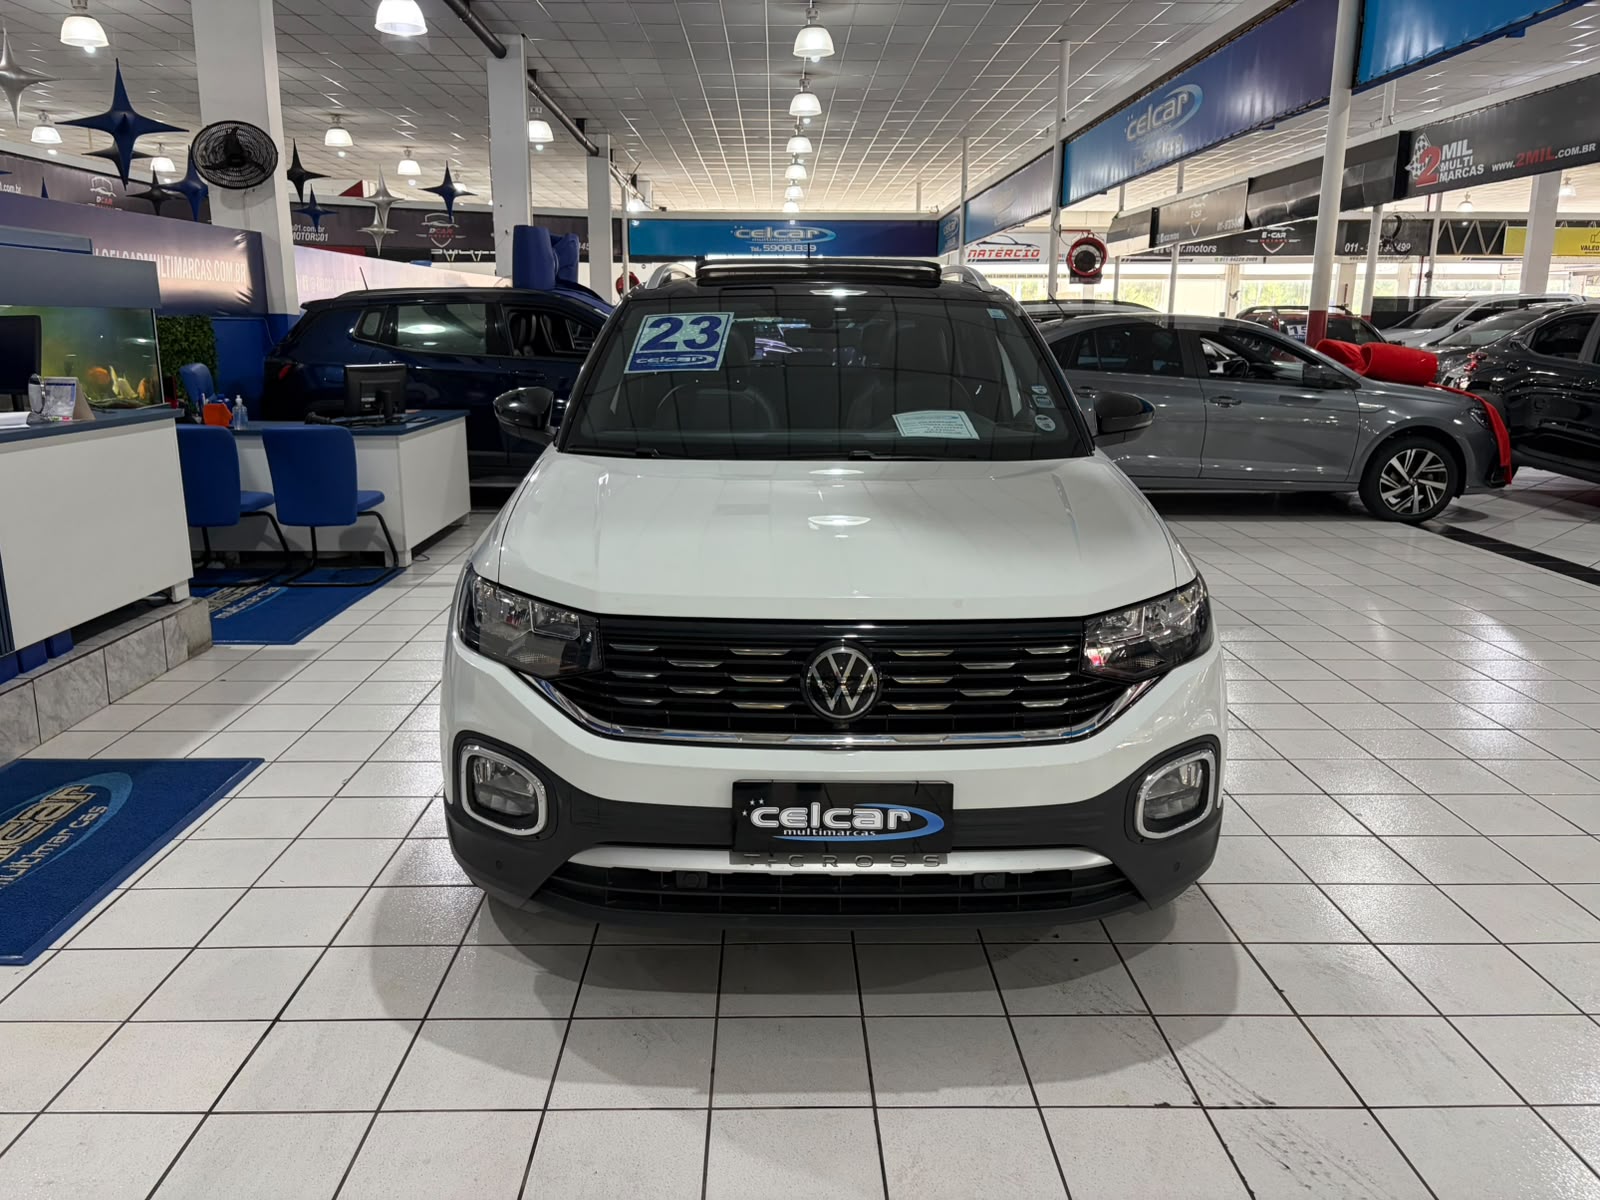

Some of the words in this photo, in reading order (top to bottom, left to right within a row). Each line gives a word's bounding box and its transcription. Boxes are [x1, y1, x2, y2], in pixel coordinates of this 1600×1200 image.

[1127, 90, 1188, 142] celcar
[1441, 139, 1473, 160] MIL
[1440, 155, 1474, 173] MULTI
[1440, 163, 1485, 183] MARCAS
[734, 227, 820, 239] celcar
[640, 315, 722, 350] 23
[751, 802, 911, 830] celcar
[783, 828, 877, 836] multimarcas
